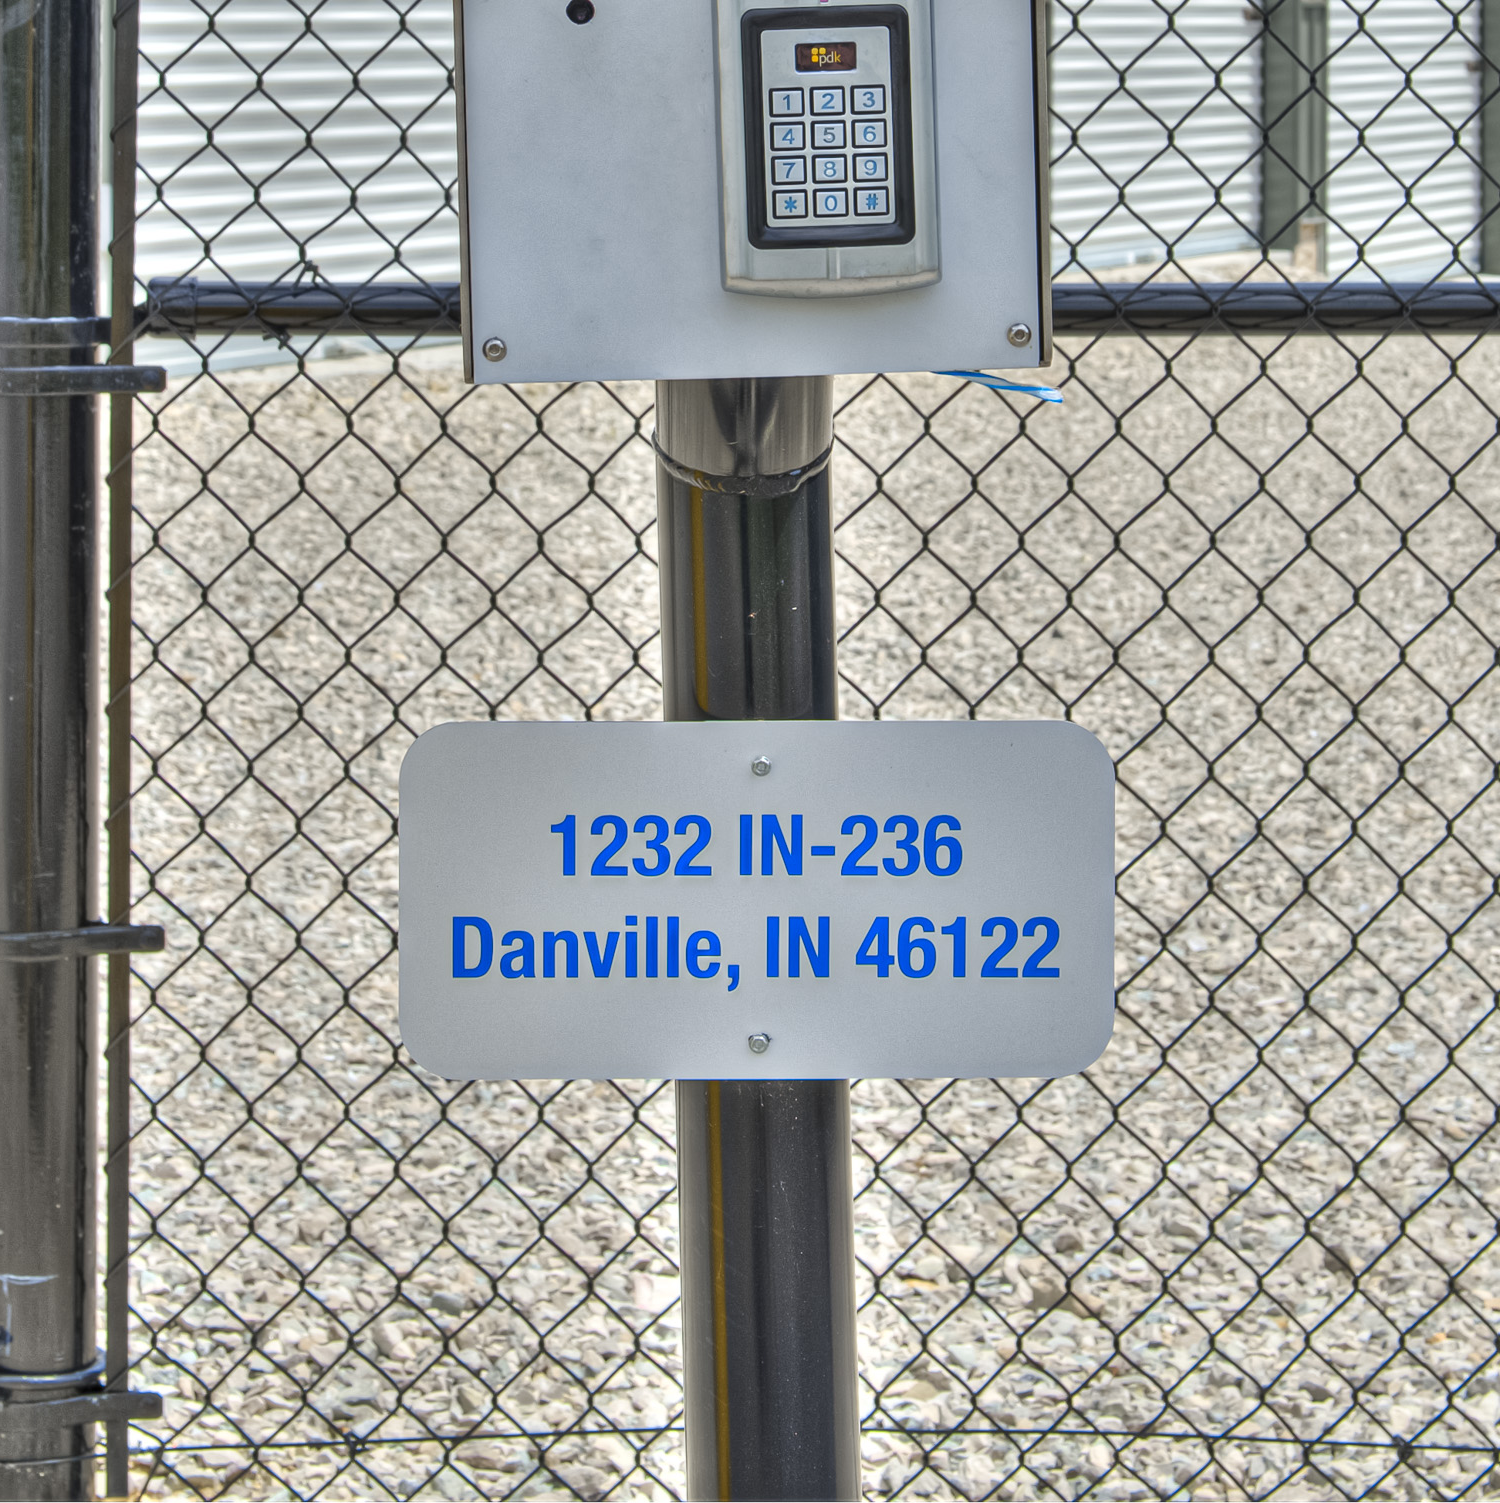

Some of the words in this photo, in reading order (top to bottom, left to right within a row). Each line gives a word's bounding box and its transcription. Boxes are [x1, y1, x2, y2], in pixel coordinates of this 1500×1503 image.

[819, 51, 841, 67] pdk
[782, 94, 791, 111] 1
[821, 93, 835, 110] 2
[862, 91, 876, 108] 3
[781, 128, 795, 145] 4
[822, 127, 836, 144] 5
[863, 125, 877, 142] 6
[782, 162, 796, 179] 7
[823, 161, 837, 178] 8
[864, 159, 878, 176] 9
[824, 195, 838, 212] 0
[550, 814, 712, 877] 1232
[739, 813, 963, 877] IN-236
[452, 915, 741, 992] Danville,
[766, 916, 830, 978] IN
[855, 916, 1060, 978] 46122
